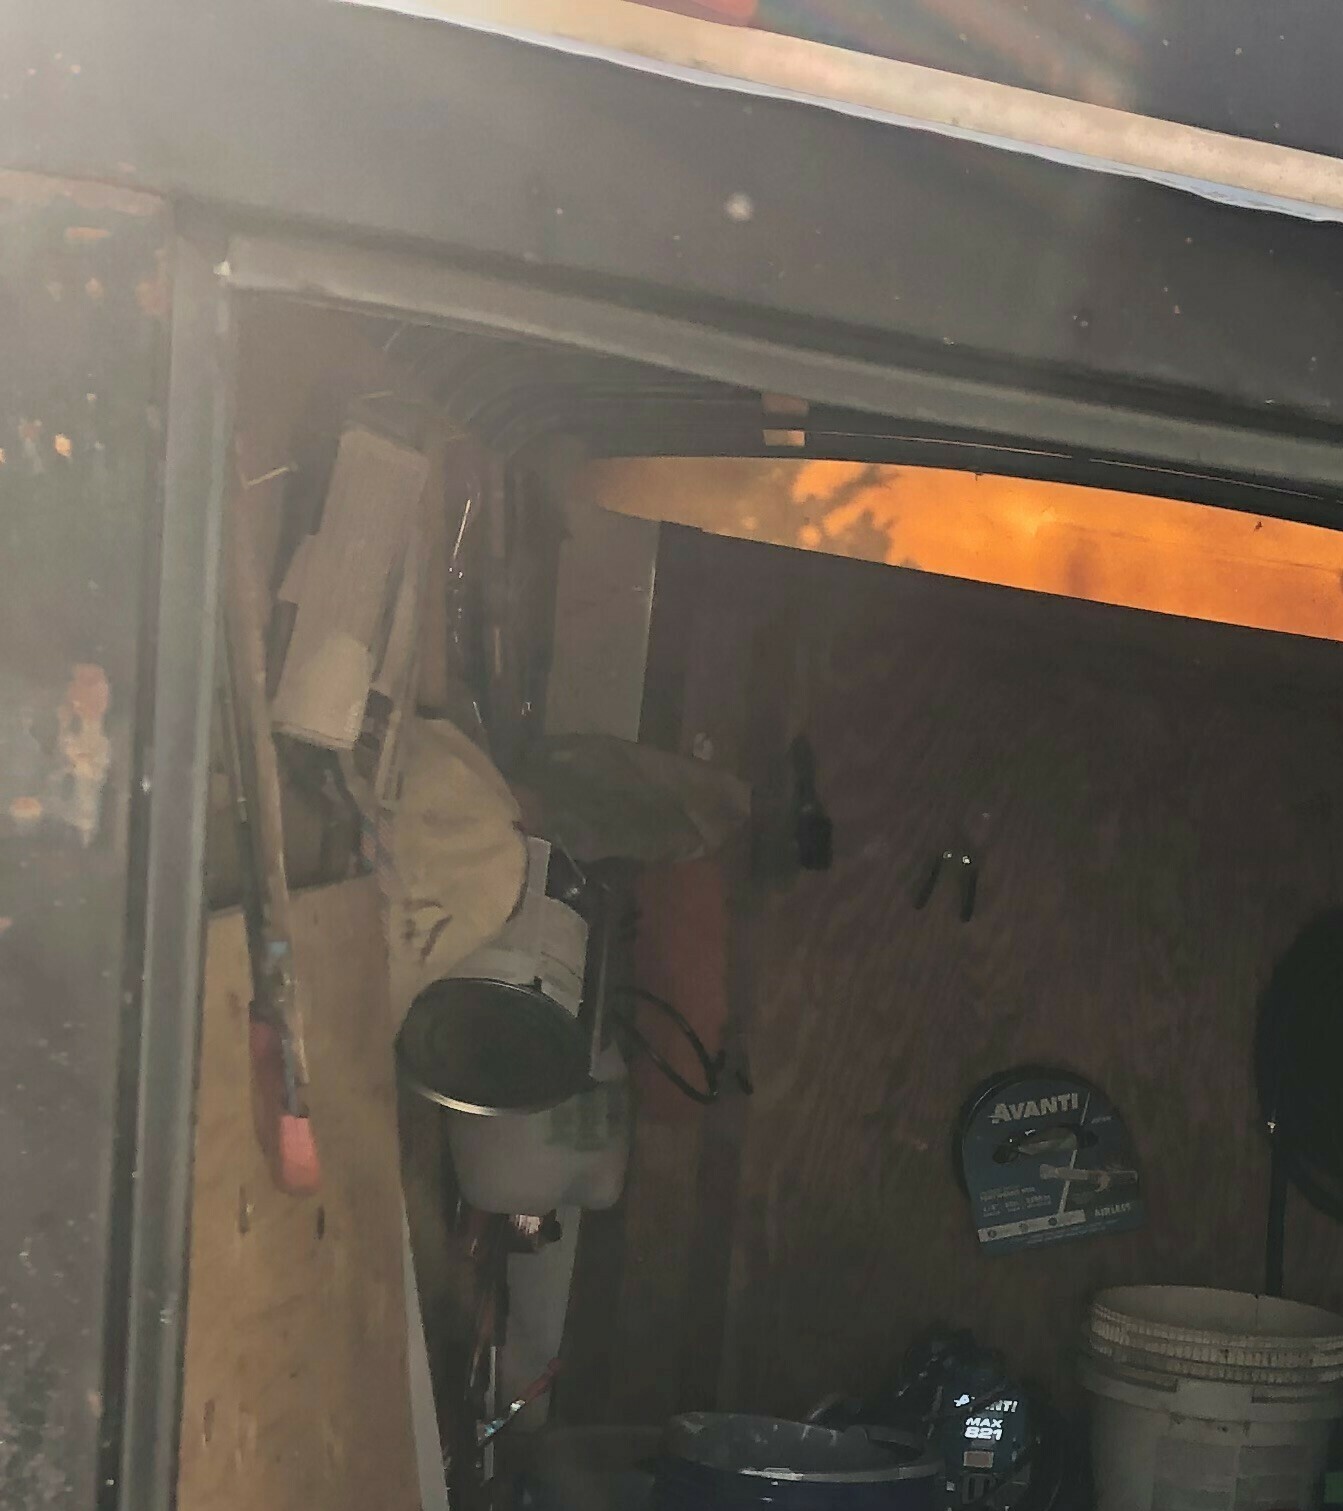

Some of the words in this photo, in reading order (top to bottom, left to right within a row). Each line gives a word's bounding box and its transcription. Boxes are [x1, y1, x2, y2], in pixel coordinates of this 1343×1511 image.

[988, 1093, 1079, 1124] AVANTI
[953, 1394, 1019, 1413] ANTI
[965, 1417, 1003, 1428] MAX
[964, 1426, 1003, 1441] 821
